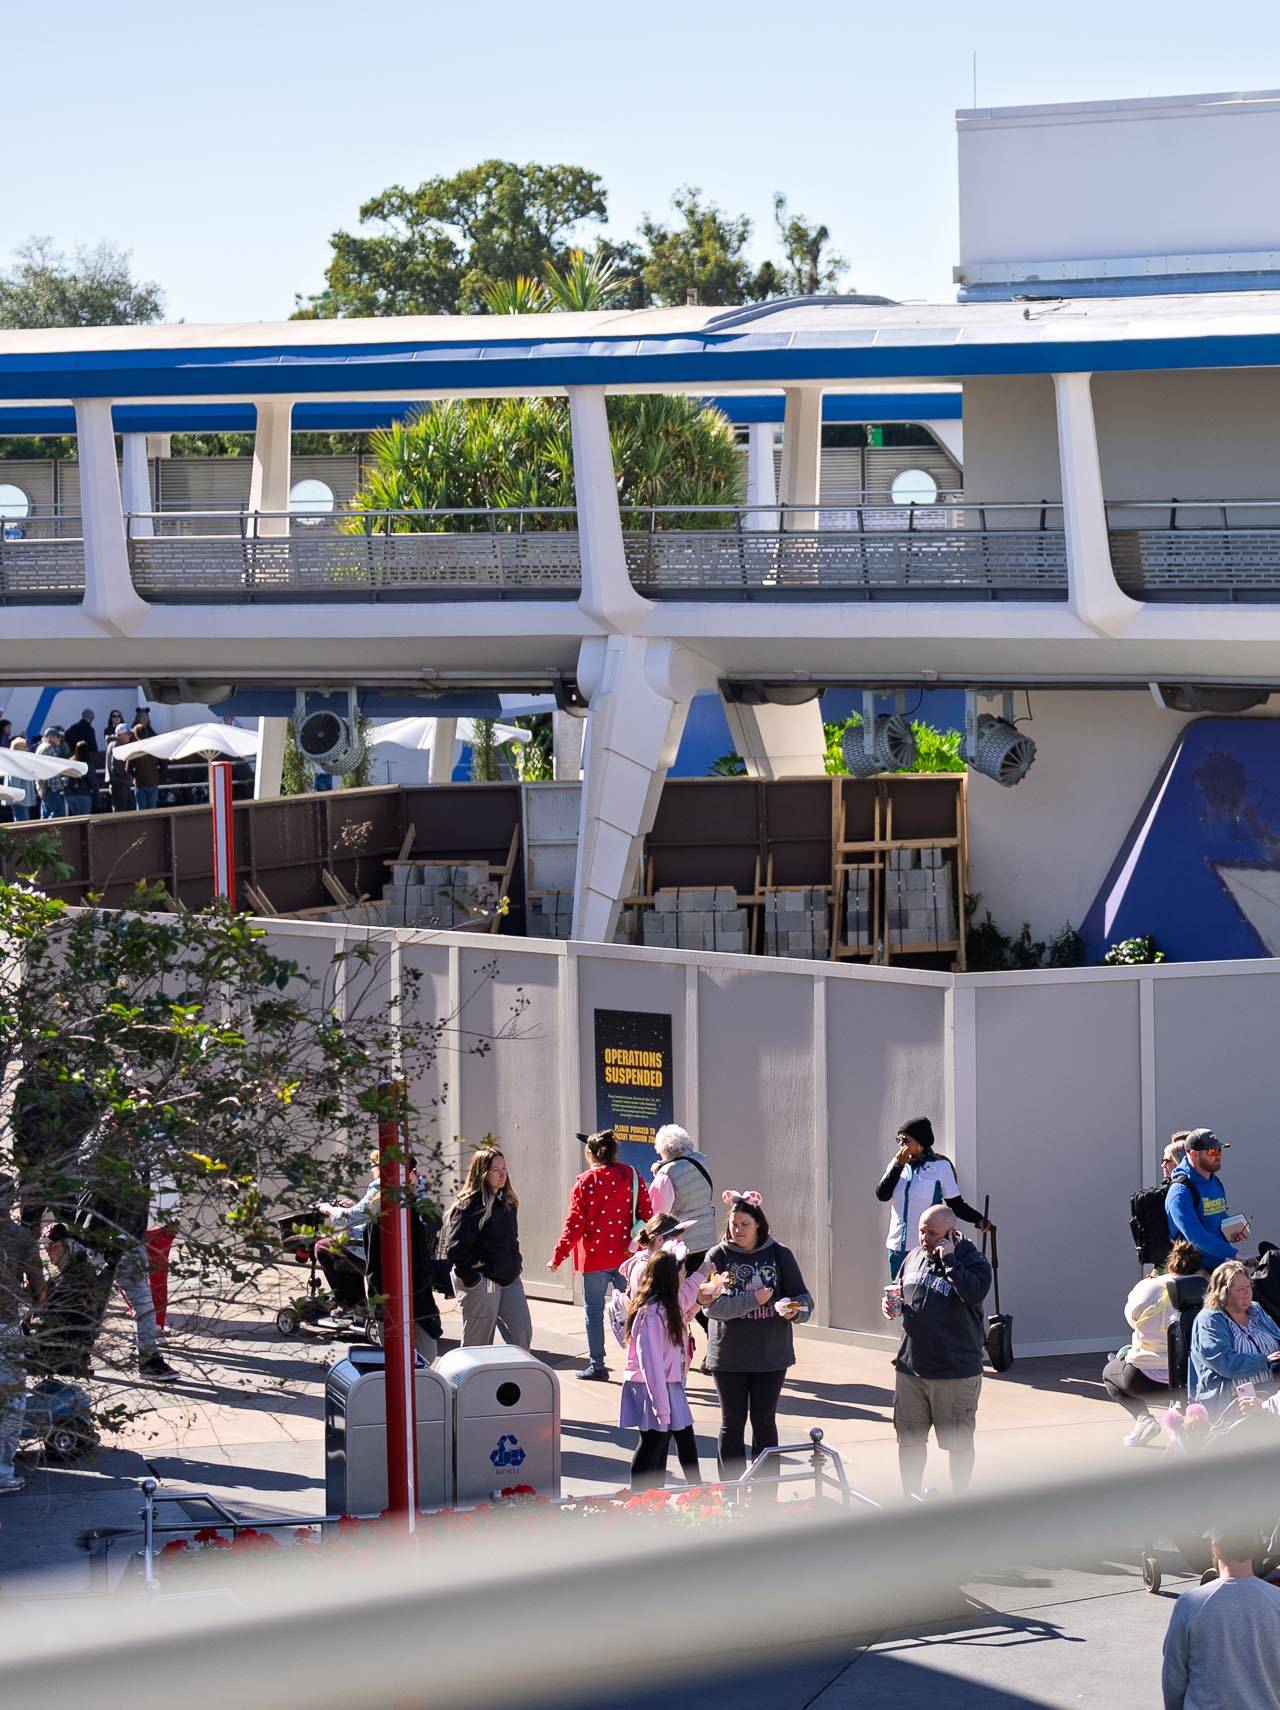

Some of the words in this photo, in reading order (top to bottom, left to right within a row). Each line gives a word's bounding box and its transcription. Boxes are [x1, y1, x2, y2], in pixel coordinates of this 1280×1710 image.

[604, 1048, 662, 1068] OPERATIONS
[605, 1066, 663, 1087] SUSPENDED
[614, 1124, 629, 1133] PLEASE
[630, 1125, 649, 1135] PROCEED
[650, 1127, 656, 1136] TO
